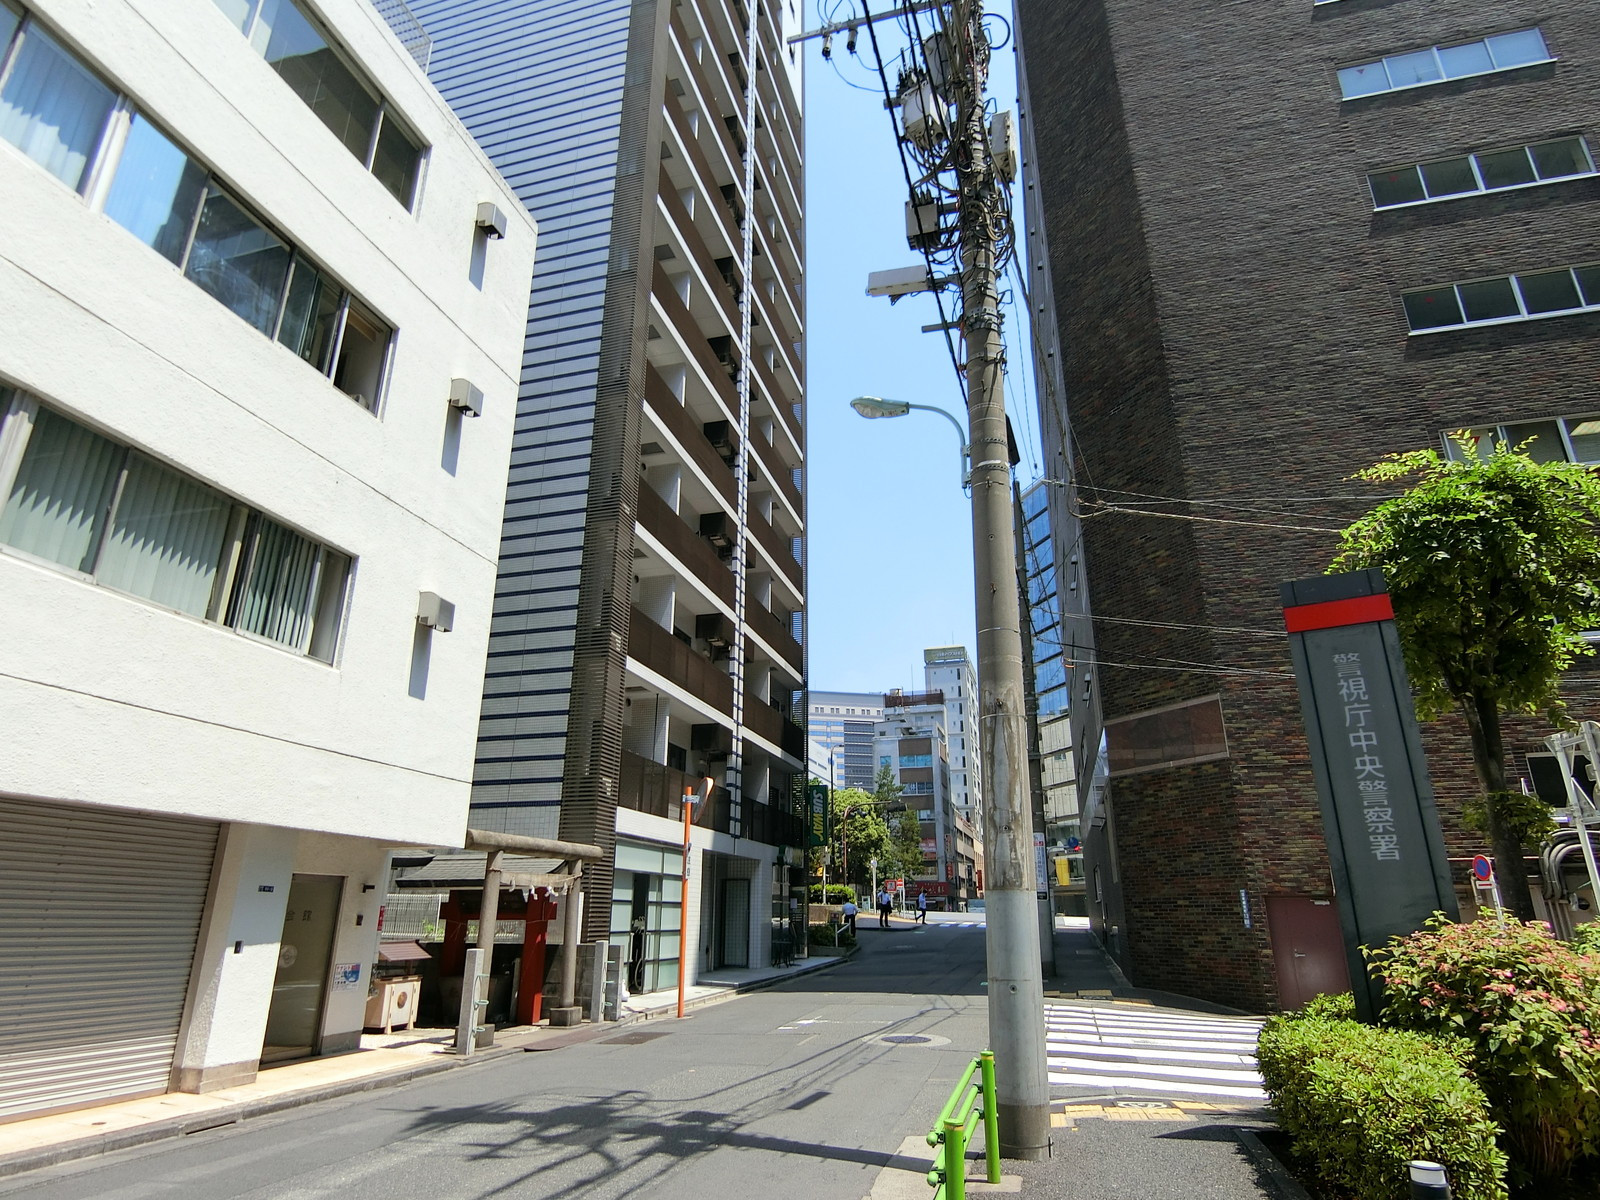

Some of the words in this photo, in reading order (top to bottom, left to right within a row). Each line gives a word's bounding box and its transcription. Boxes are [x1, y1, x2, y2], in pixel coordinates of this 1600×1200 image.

[813, 789, 824, 842] SUBWAY
[1333, 652, 1400, 861] 警視庁中央警察署
